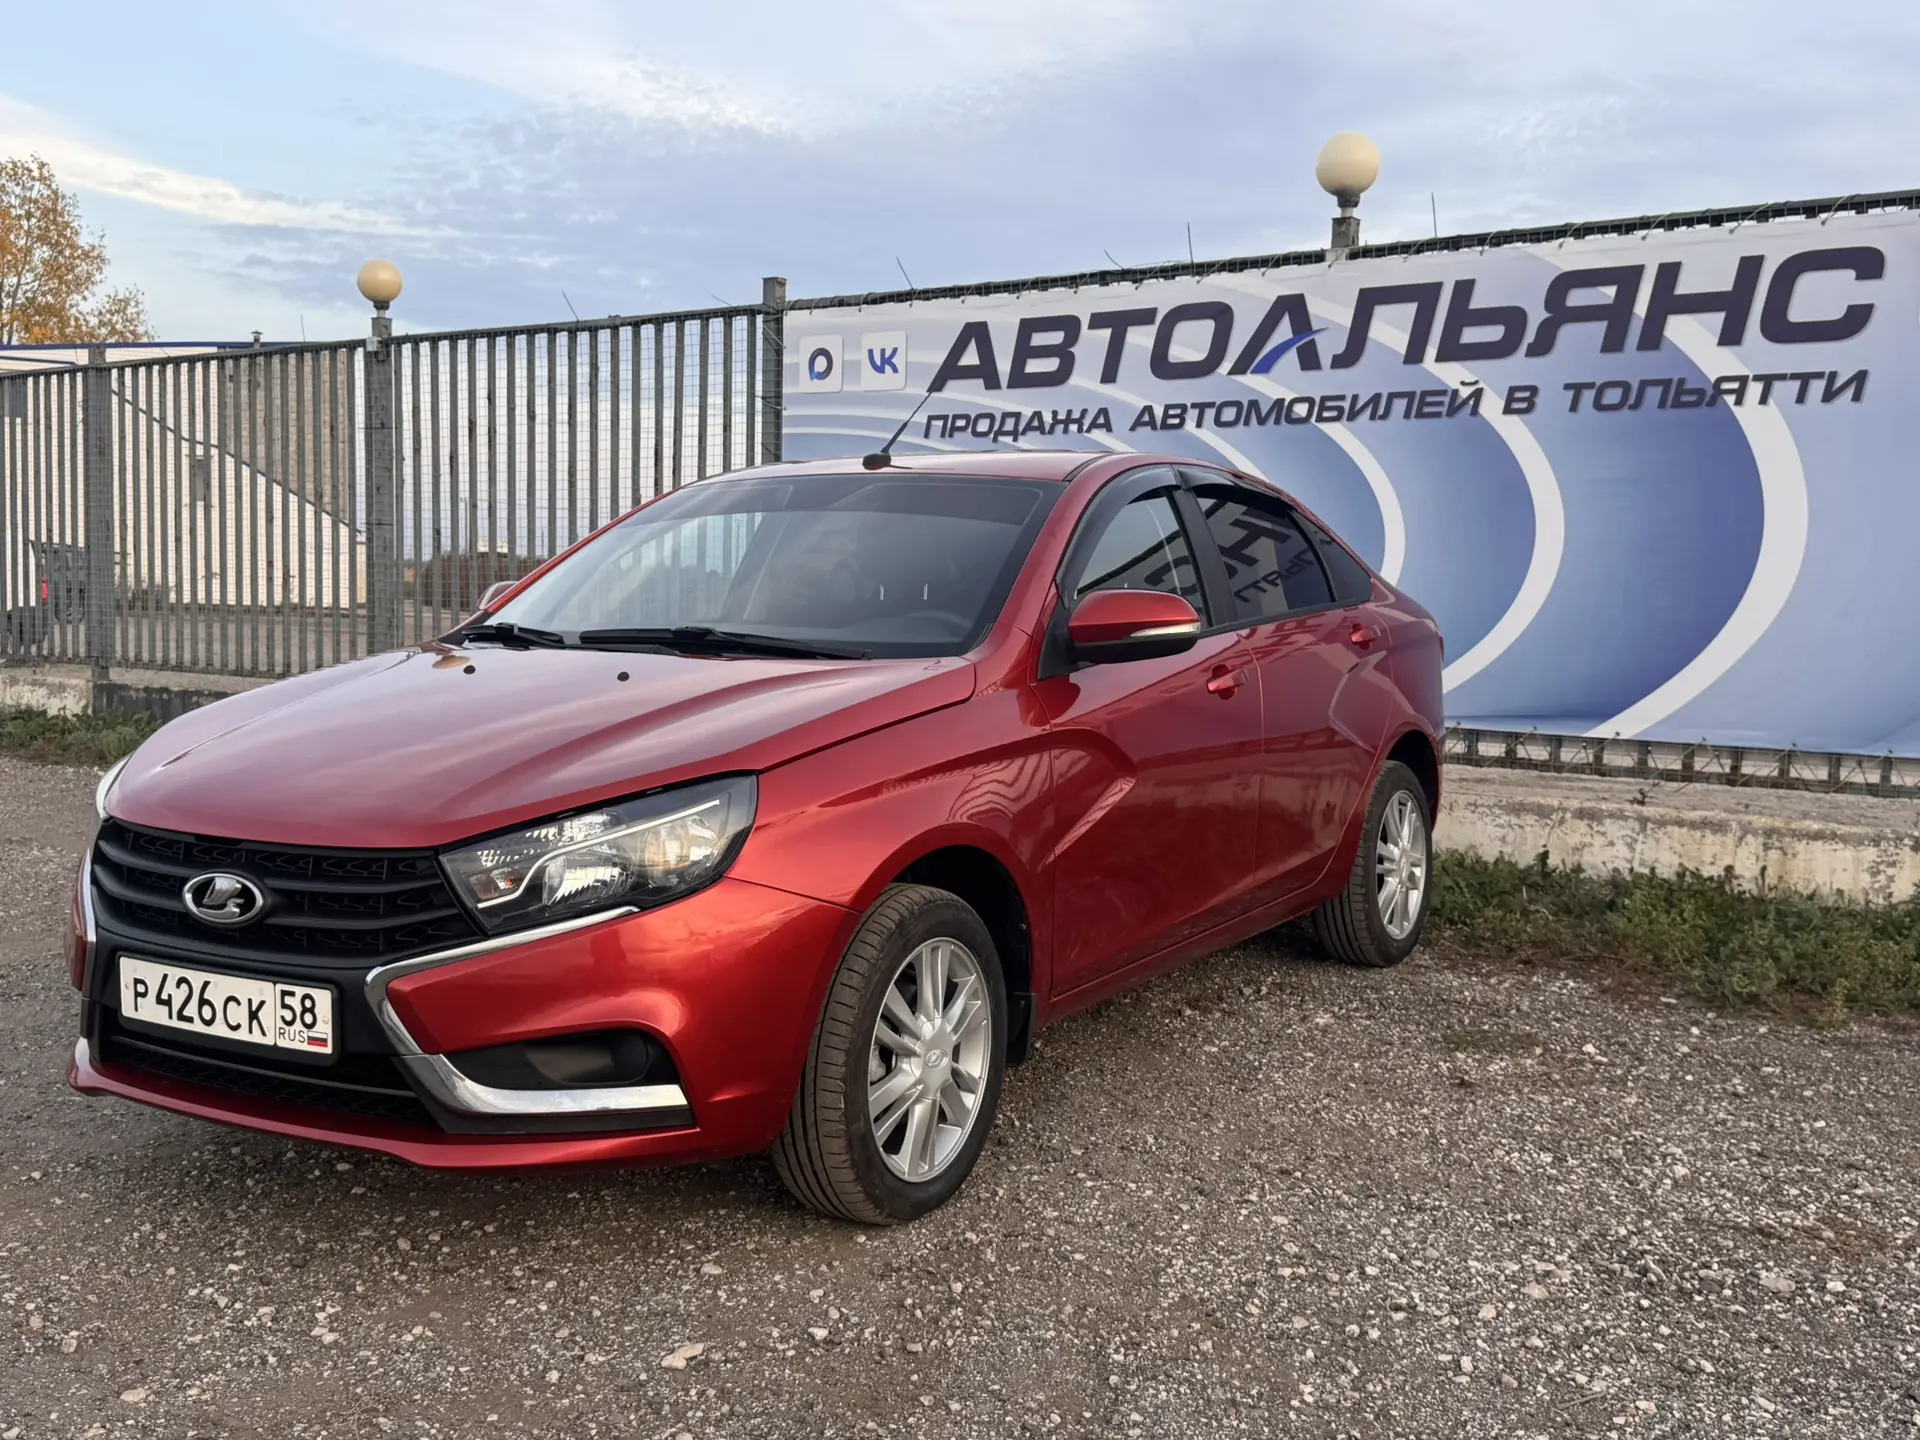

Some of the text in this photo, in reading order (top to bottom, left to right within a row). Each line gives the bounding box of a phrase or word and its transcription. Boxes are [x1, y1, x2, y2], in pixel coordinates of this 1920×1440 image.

[927, 246, 1885, 393] АВТОАЛЬЯНС
[923, 369, 1868, 443] ПРОДАЖА АВТОМОБИЛЕЙ В ТОЛЬЯТТИ
[278, 1026, 306, 1044] RUS
[280, 988, 318, 1030] 58
